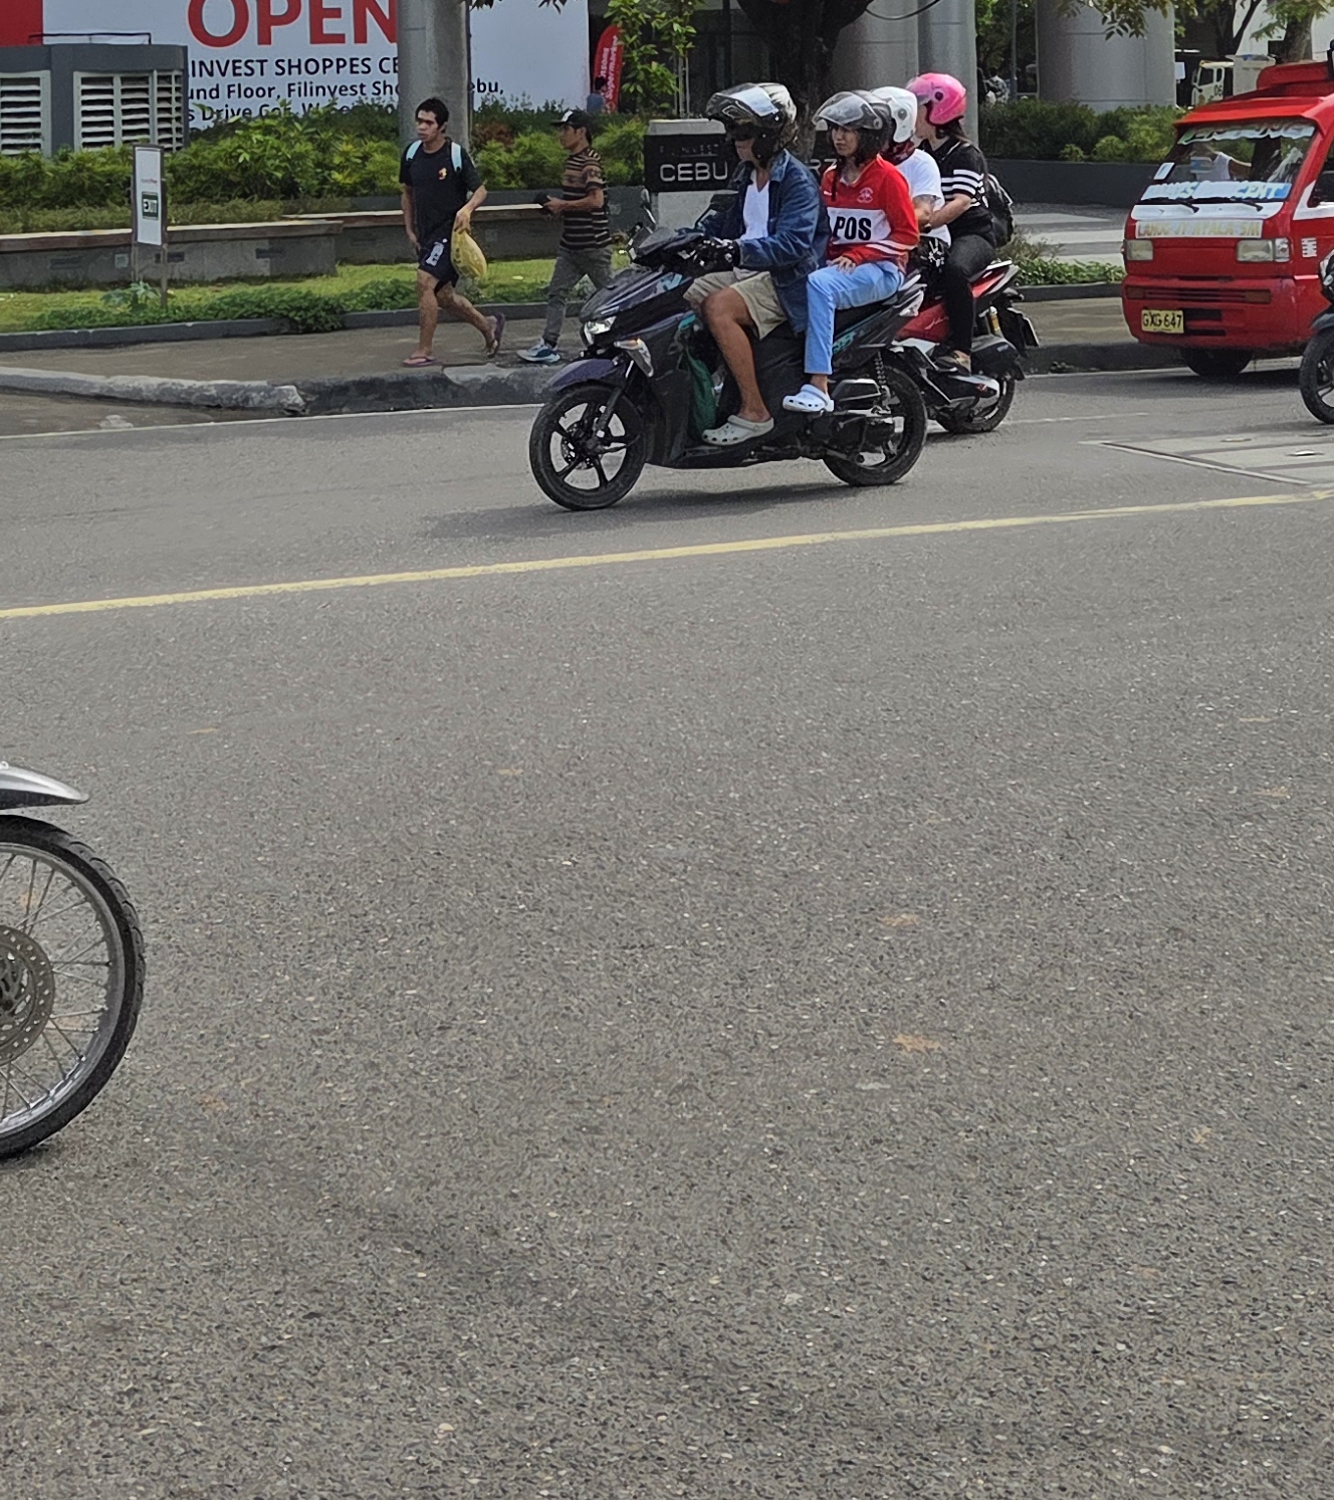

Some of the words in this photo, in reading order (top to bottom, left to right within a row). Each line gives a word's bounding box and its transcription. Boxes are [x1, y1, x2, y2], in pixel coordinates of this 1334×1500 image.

[275, 57, 372, 77] SHOPPES
[226, 81, 281, 100] Floor,
[287, 78, 367, 98] Filinvest
[659, 161, 728, 182] CEBU
[832, 215, 872, 241] POS
